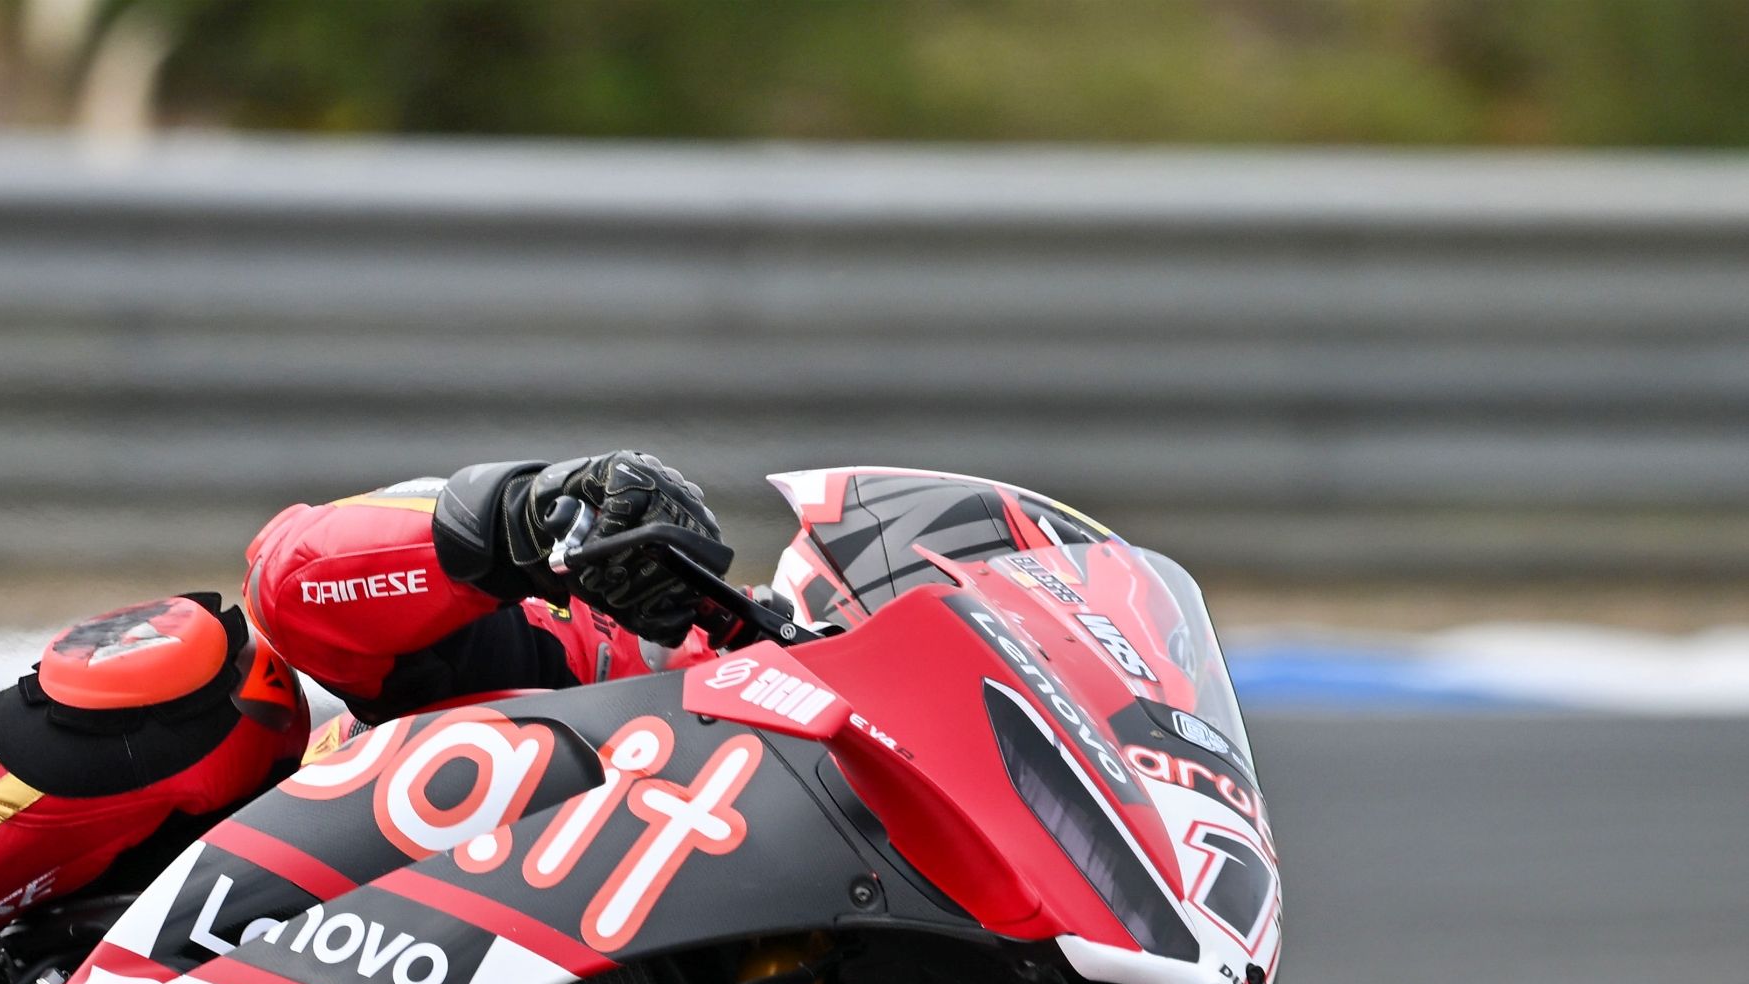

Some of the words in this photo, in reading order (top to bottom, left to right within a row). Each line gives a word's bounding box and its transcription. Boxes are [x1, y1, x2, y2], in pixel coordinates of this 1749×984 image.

[301, 568, 429, 605] DAINESE
[1074, 614, 1159, 683] WRS
[970, 612, 1127, 785] Lenovo
